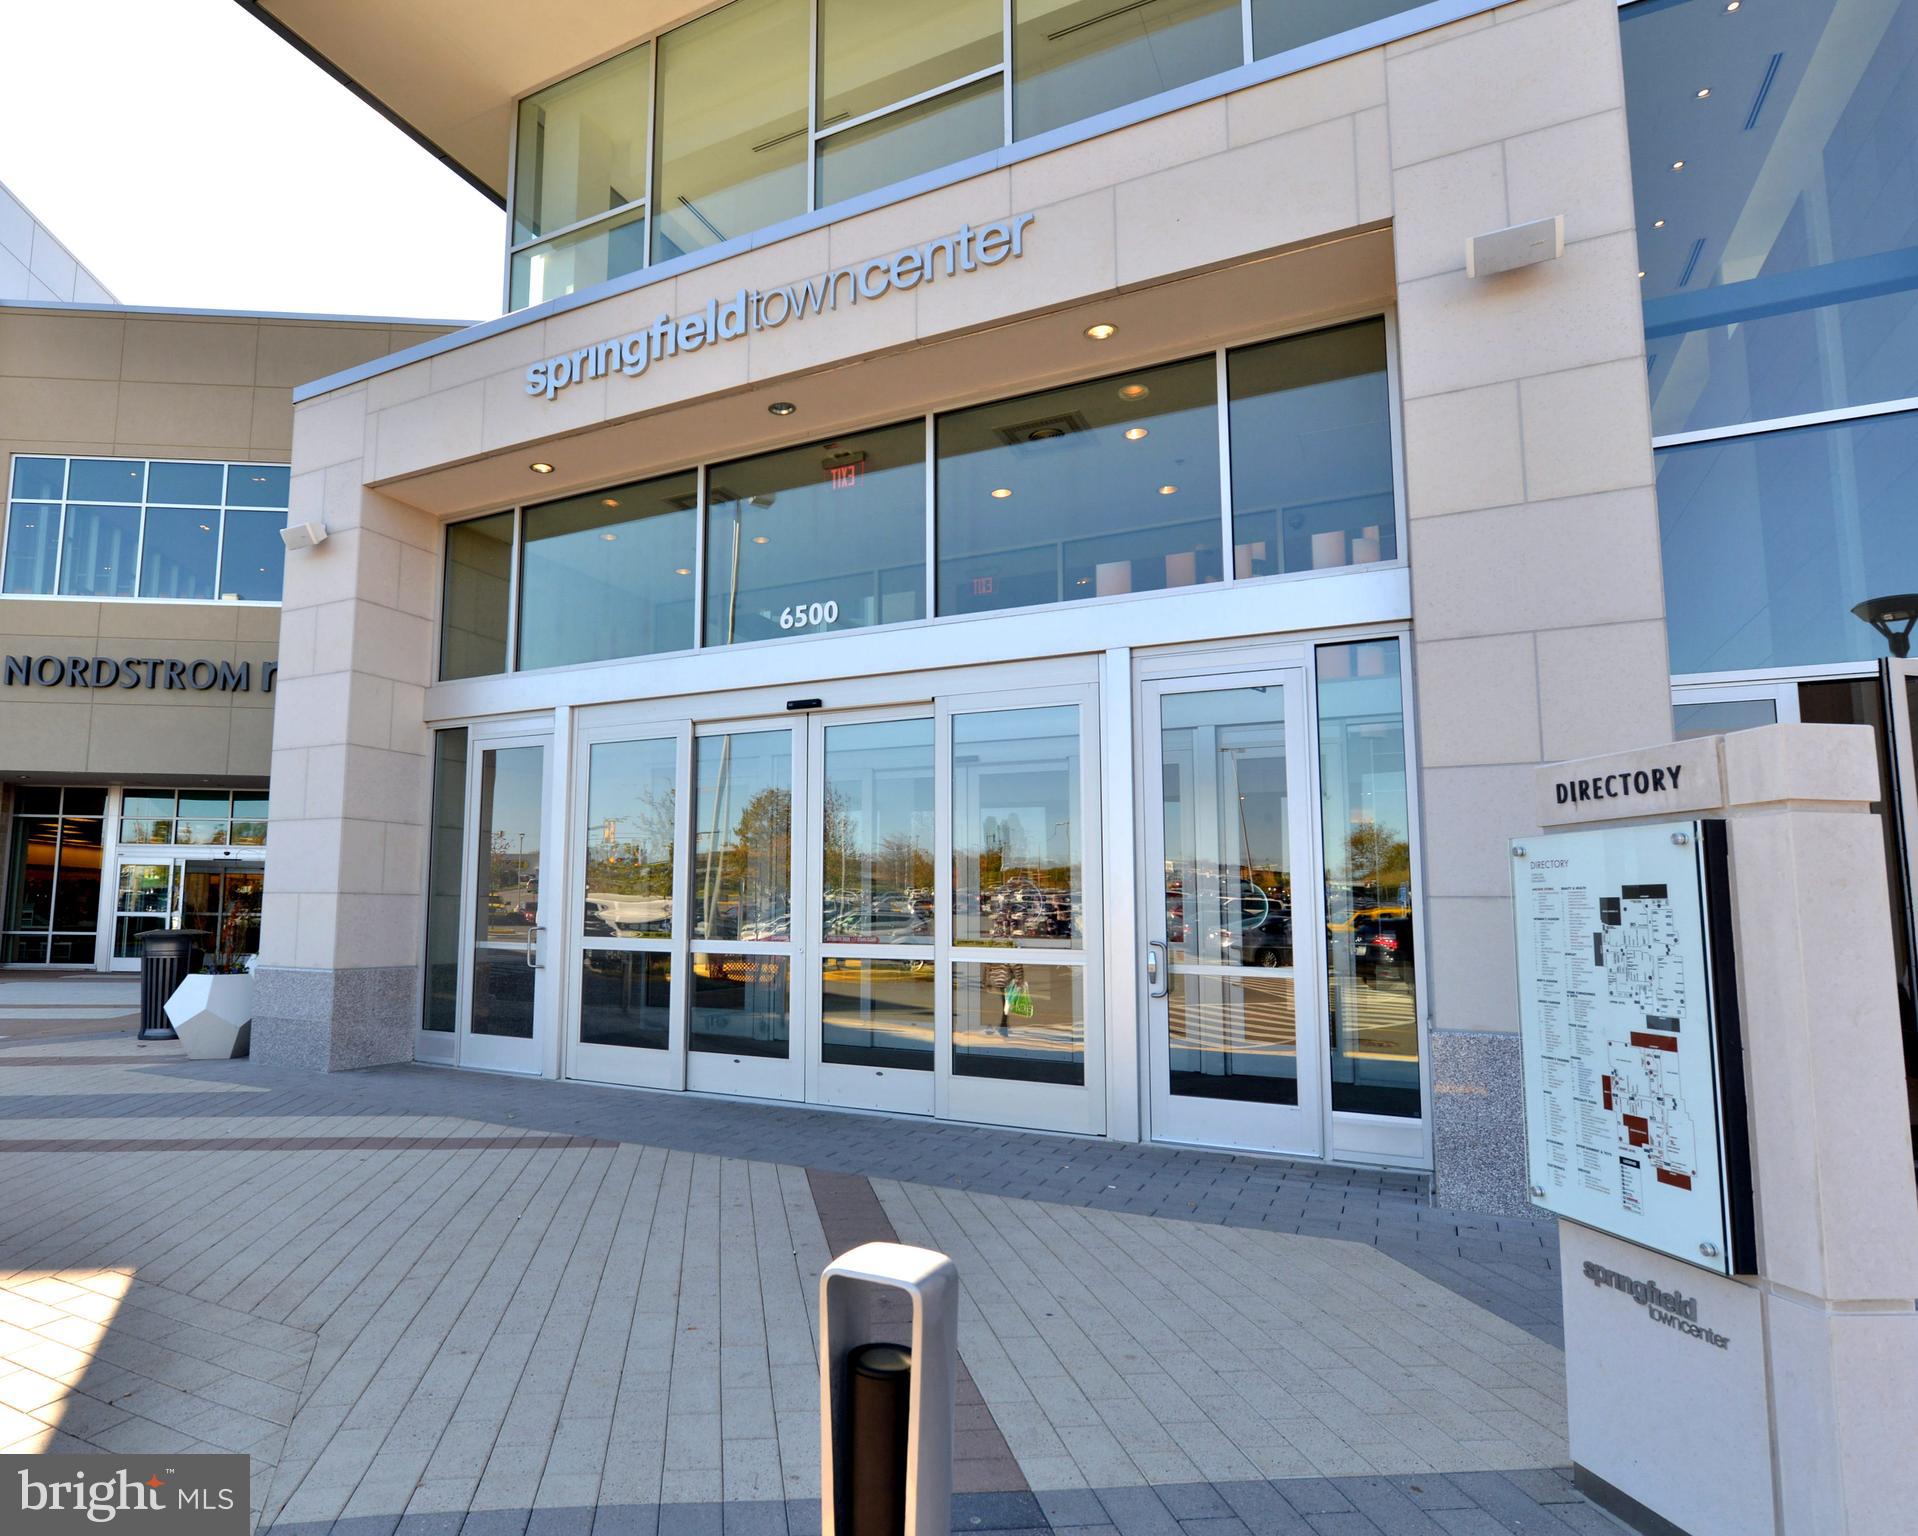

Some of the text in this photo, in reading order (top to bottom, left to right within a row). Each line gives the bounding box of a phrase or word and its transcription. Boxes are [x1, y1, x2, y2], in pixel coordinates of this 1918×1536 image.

[779, 600, 839, 629] 6500
[3, 655, 250, 692] NORDSTROM
[1555, 765, 1683, 804] DIRECTORY
[1529, 858, 1569, 870] DIRECTORY
[1583, 1260, 1698, 1322] springfield
[1649, 1303, 1730, 1350] towncenter
